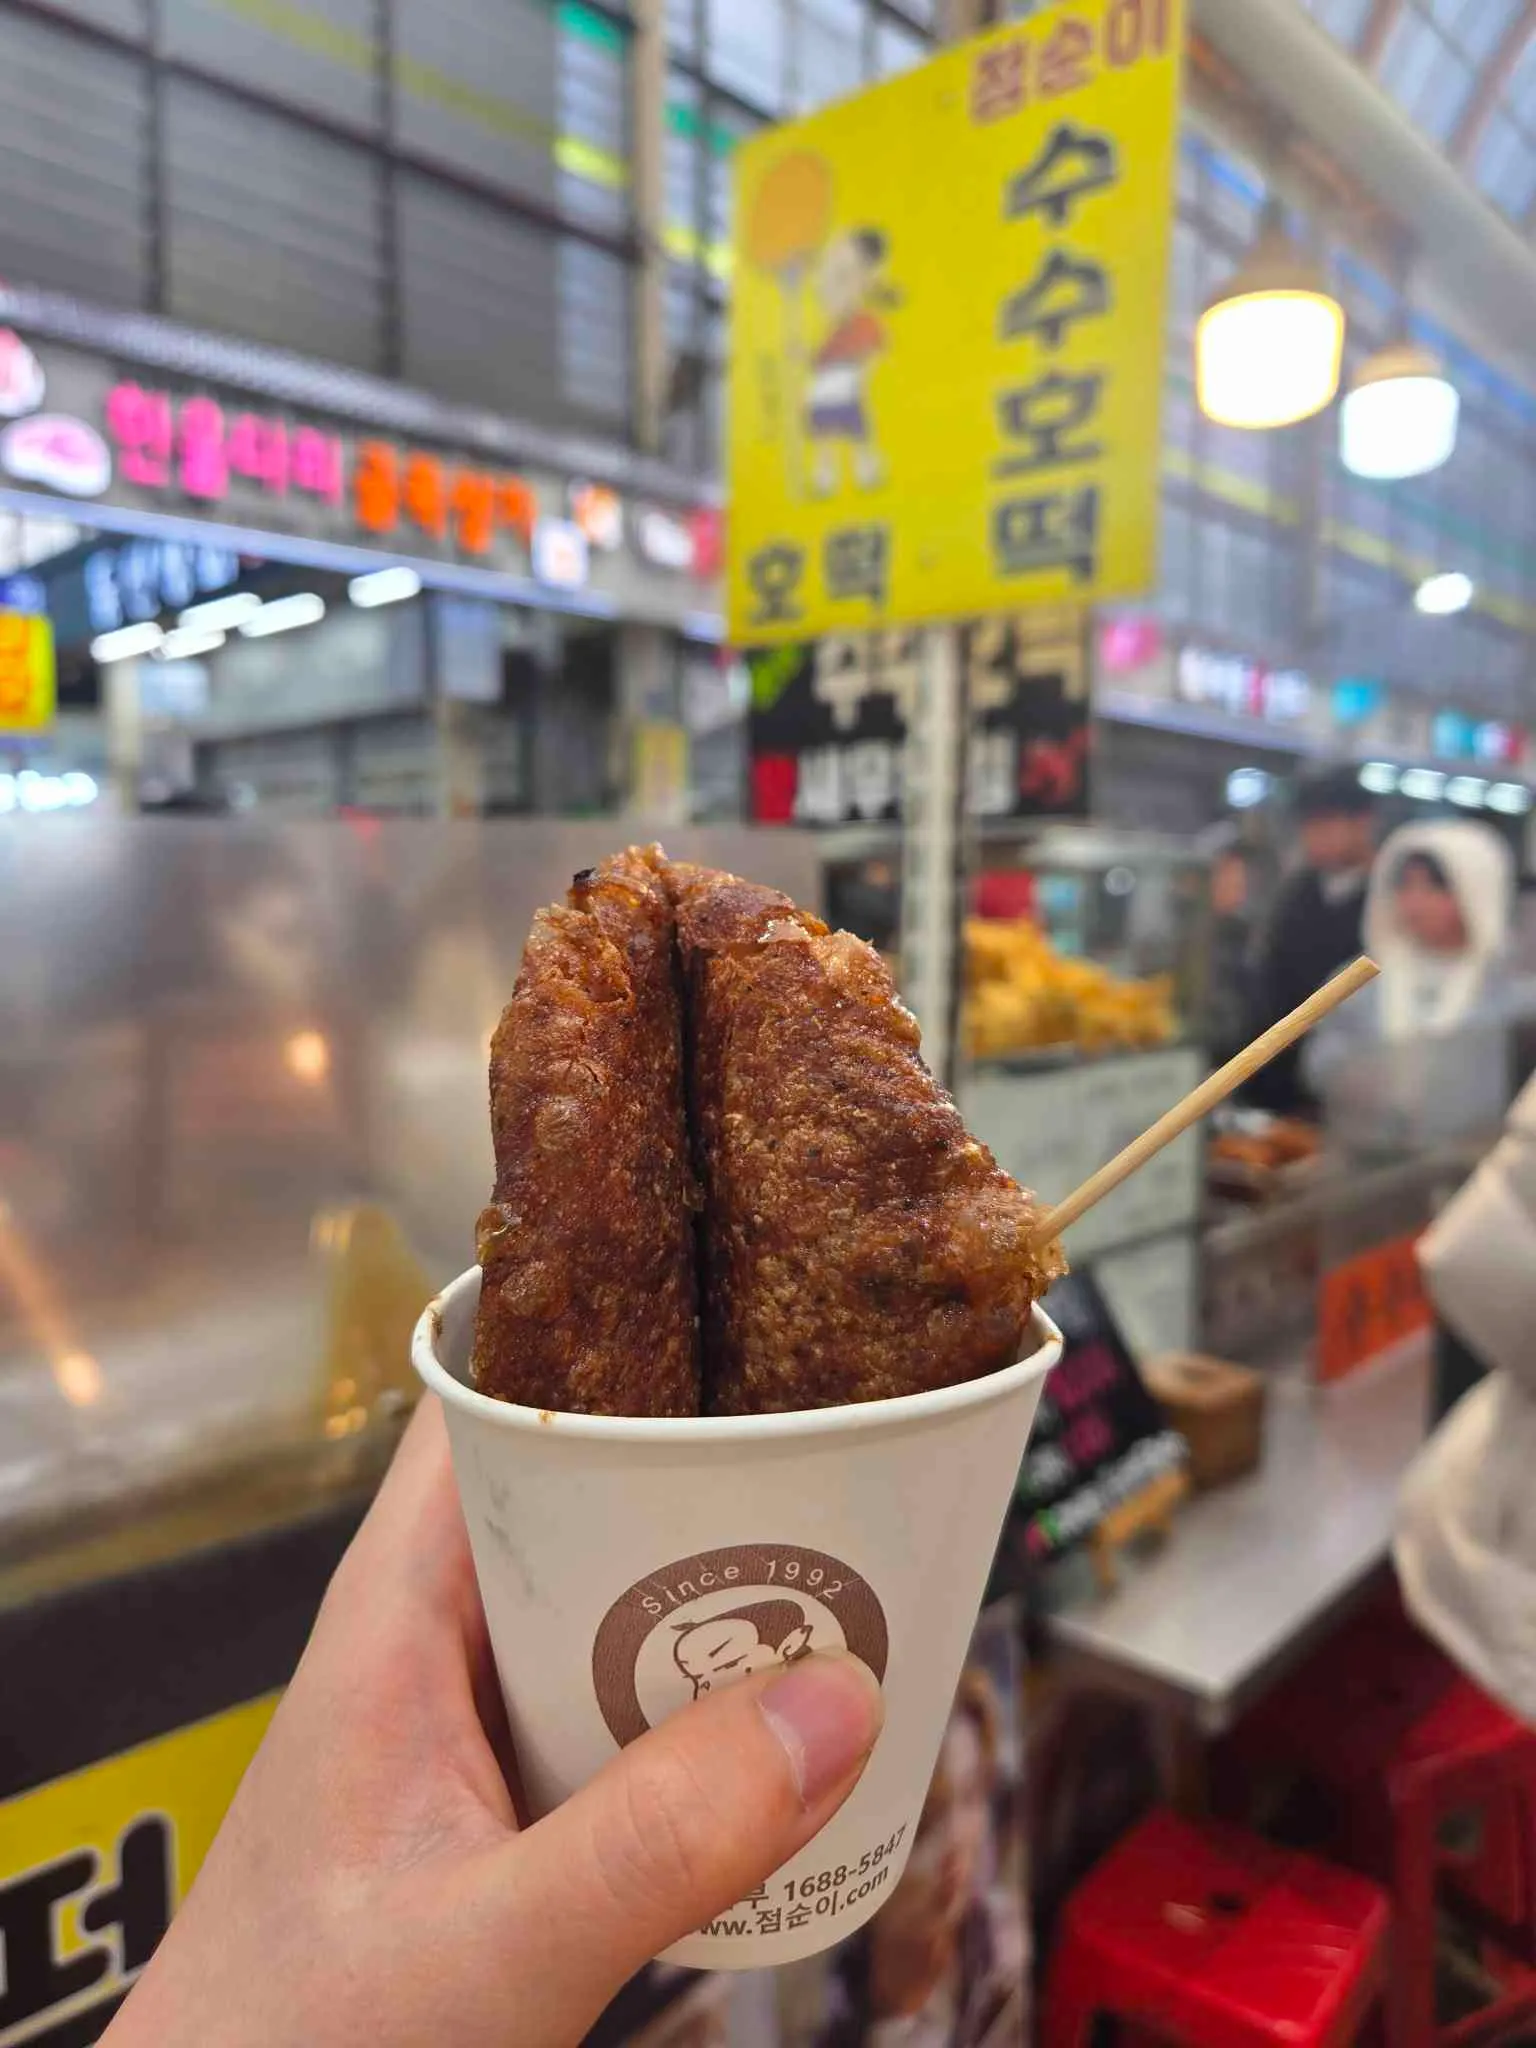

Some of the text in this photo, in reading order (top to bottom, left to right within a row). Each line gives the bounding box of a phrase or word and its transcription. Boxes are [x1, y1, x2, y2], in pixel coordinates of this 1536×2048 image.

[641, 1558, 844, 1615] Since 1992
[784, 1822, 908, 1903] 1688-5847
[700, 1865, 890, 1937] ww.점순이.com
